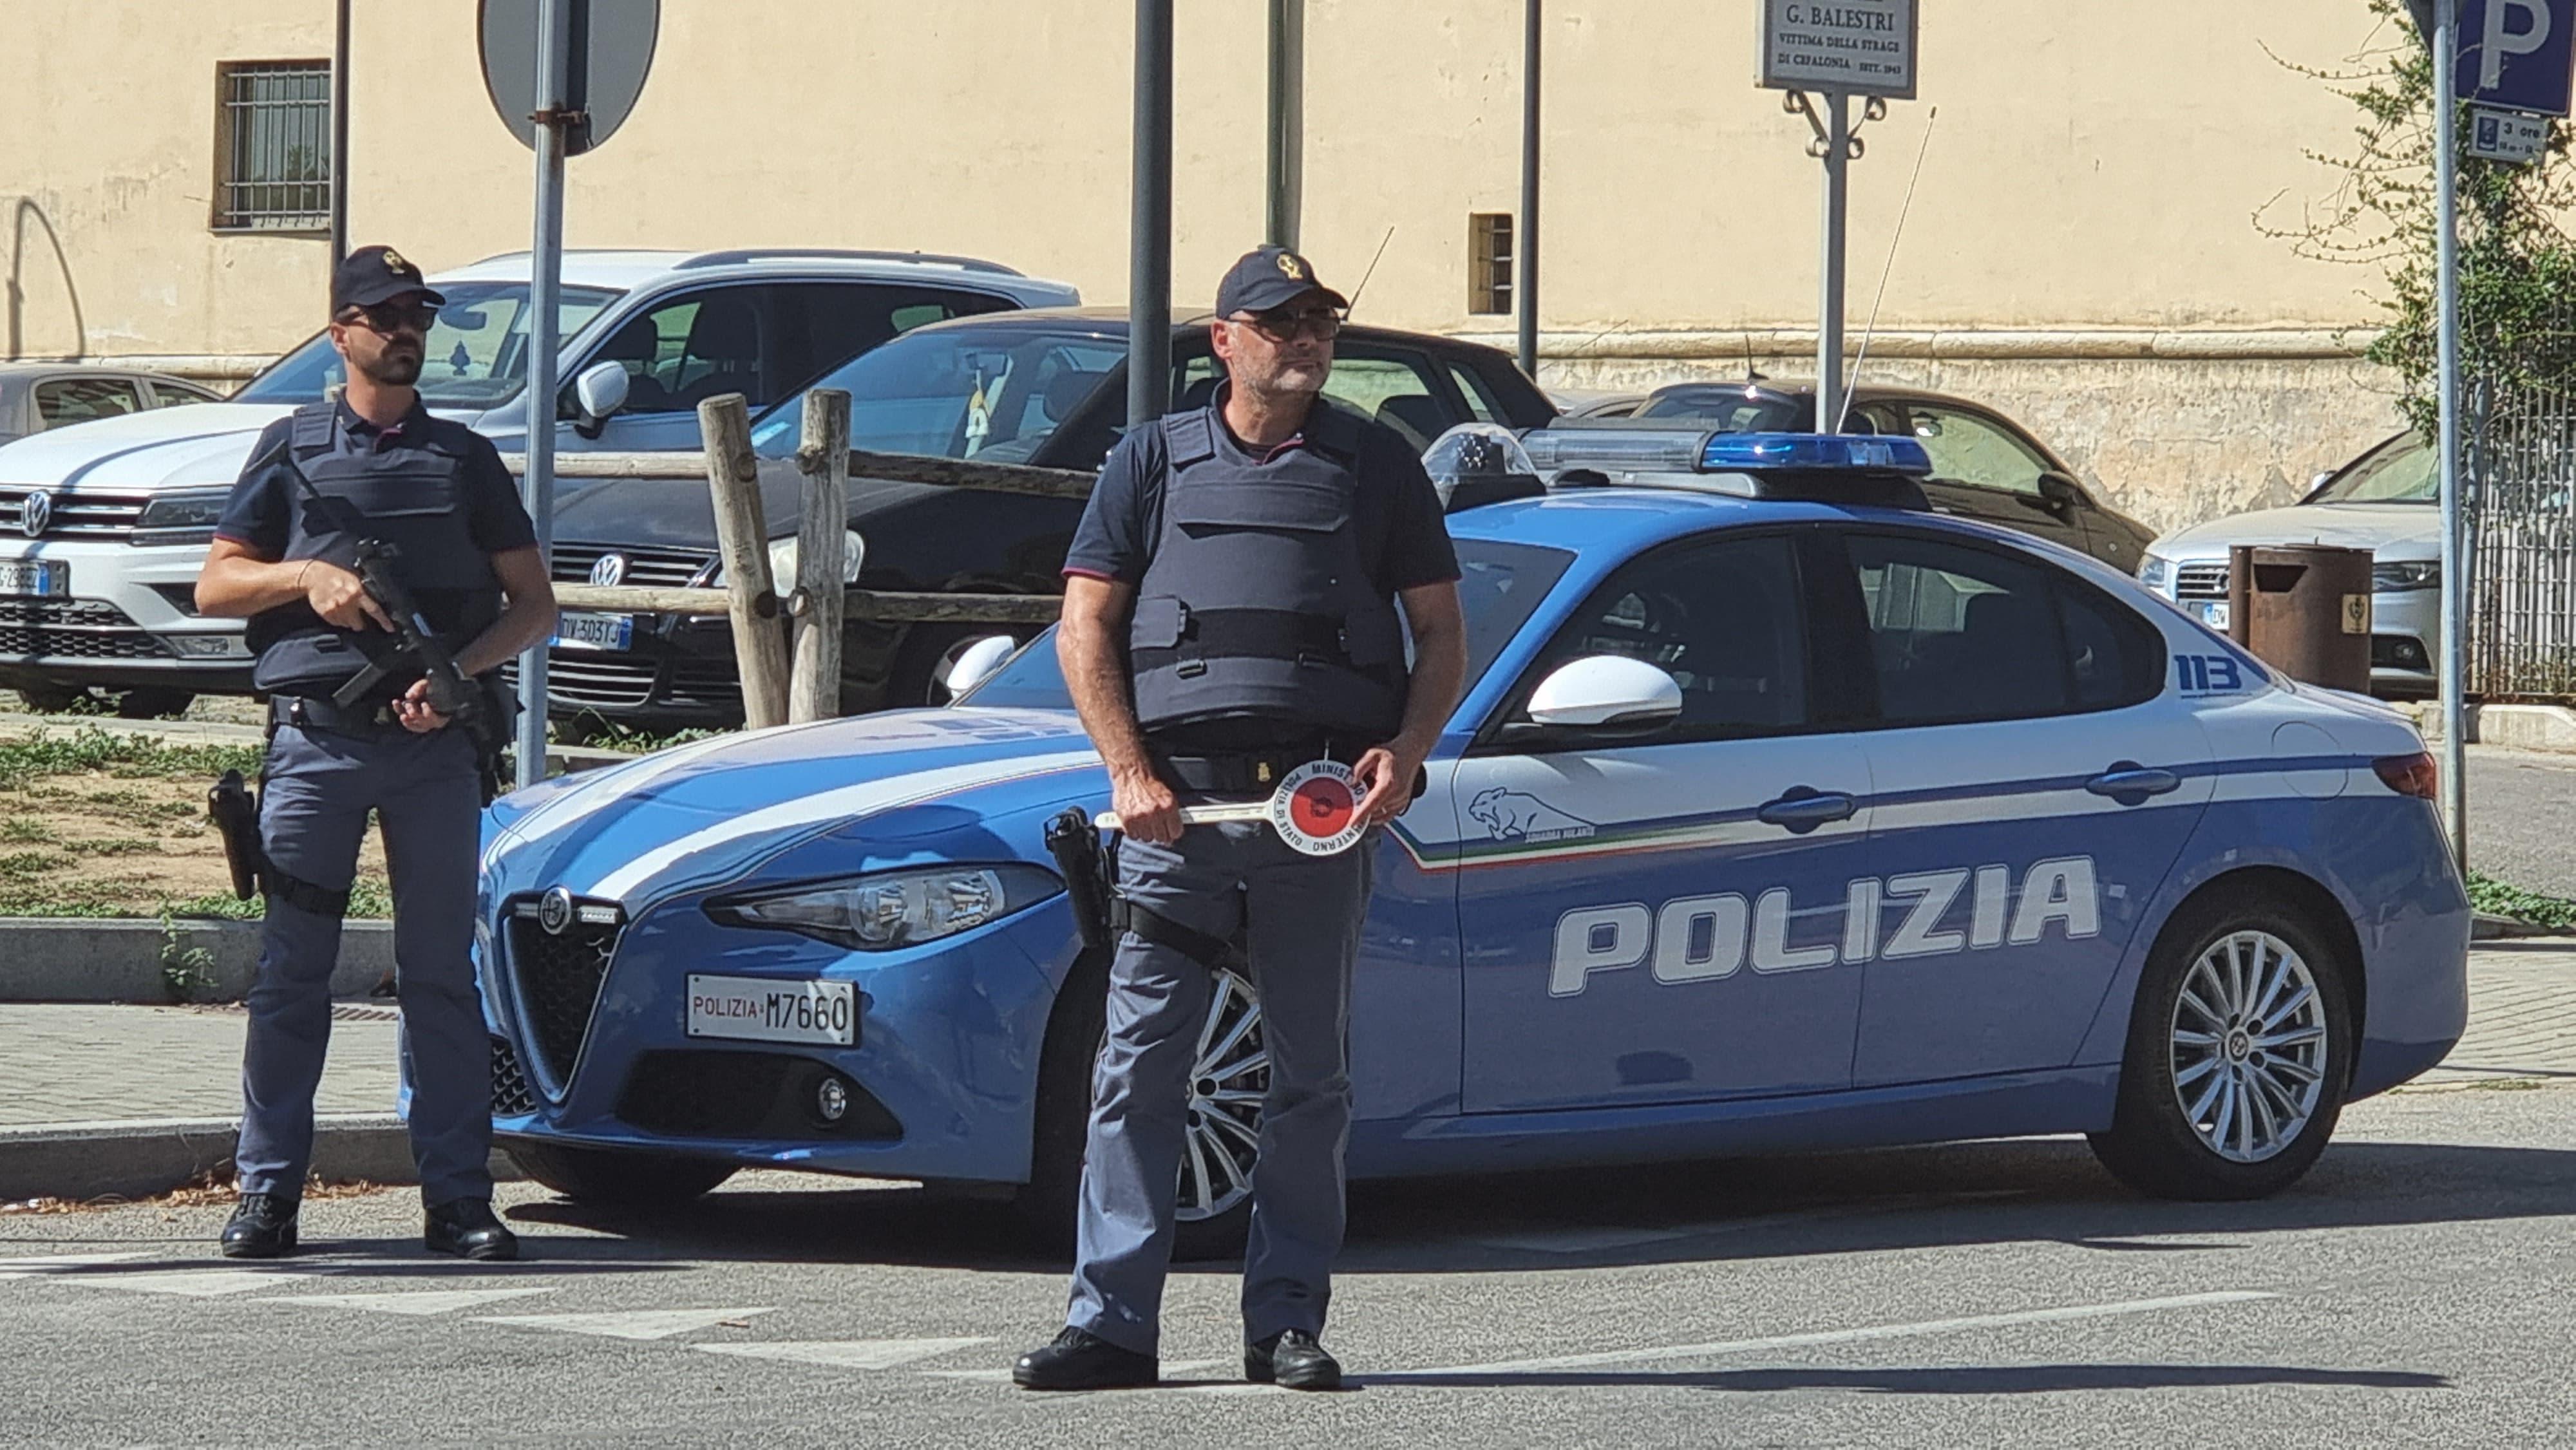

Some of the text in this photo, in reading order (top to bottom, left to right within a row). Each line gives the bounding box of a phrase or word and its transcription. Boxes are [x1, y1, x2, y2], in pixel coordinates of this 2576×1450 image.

[1786, 5, 1895, 32] G. BALESTRI
[1779, 33, 1900, 53] VITTIMA DELLA STRAGE
[2479, 0, 2551, 89] P
[1777, 53, 1790, 64] DI
[1793, 54, 1851, 69] CEFALONIA
[2503, 122, 2540, 139] 3 ore
[2174, 655, 2242, 690] 113
[1276, 773, 1303, 846] POLIZIA DI STATO
[1548, 855, 2101, 997] POLIZIA
[693, 992, 848, 1031] POLIZIA M7660
